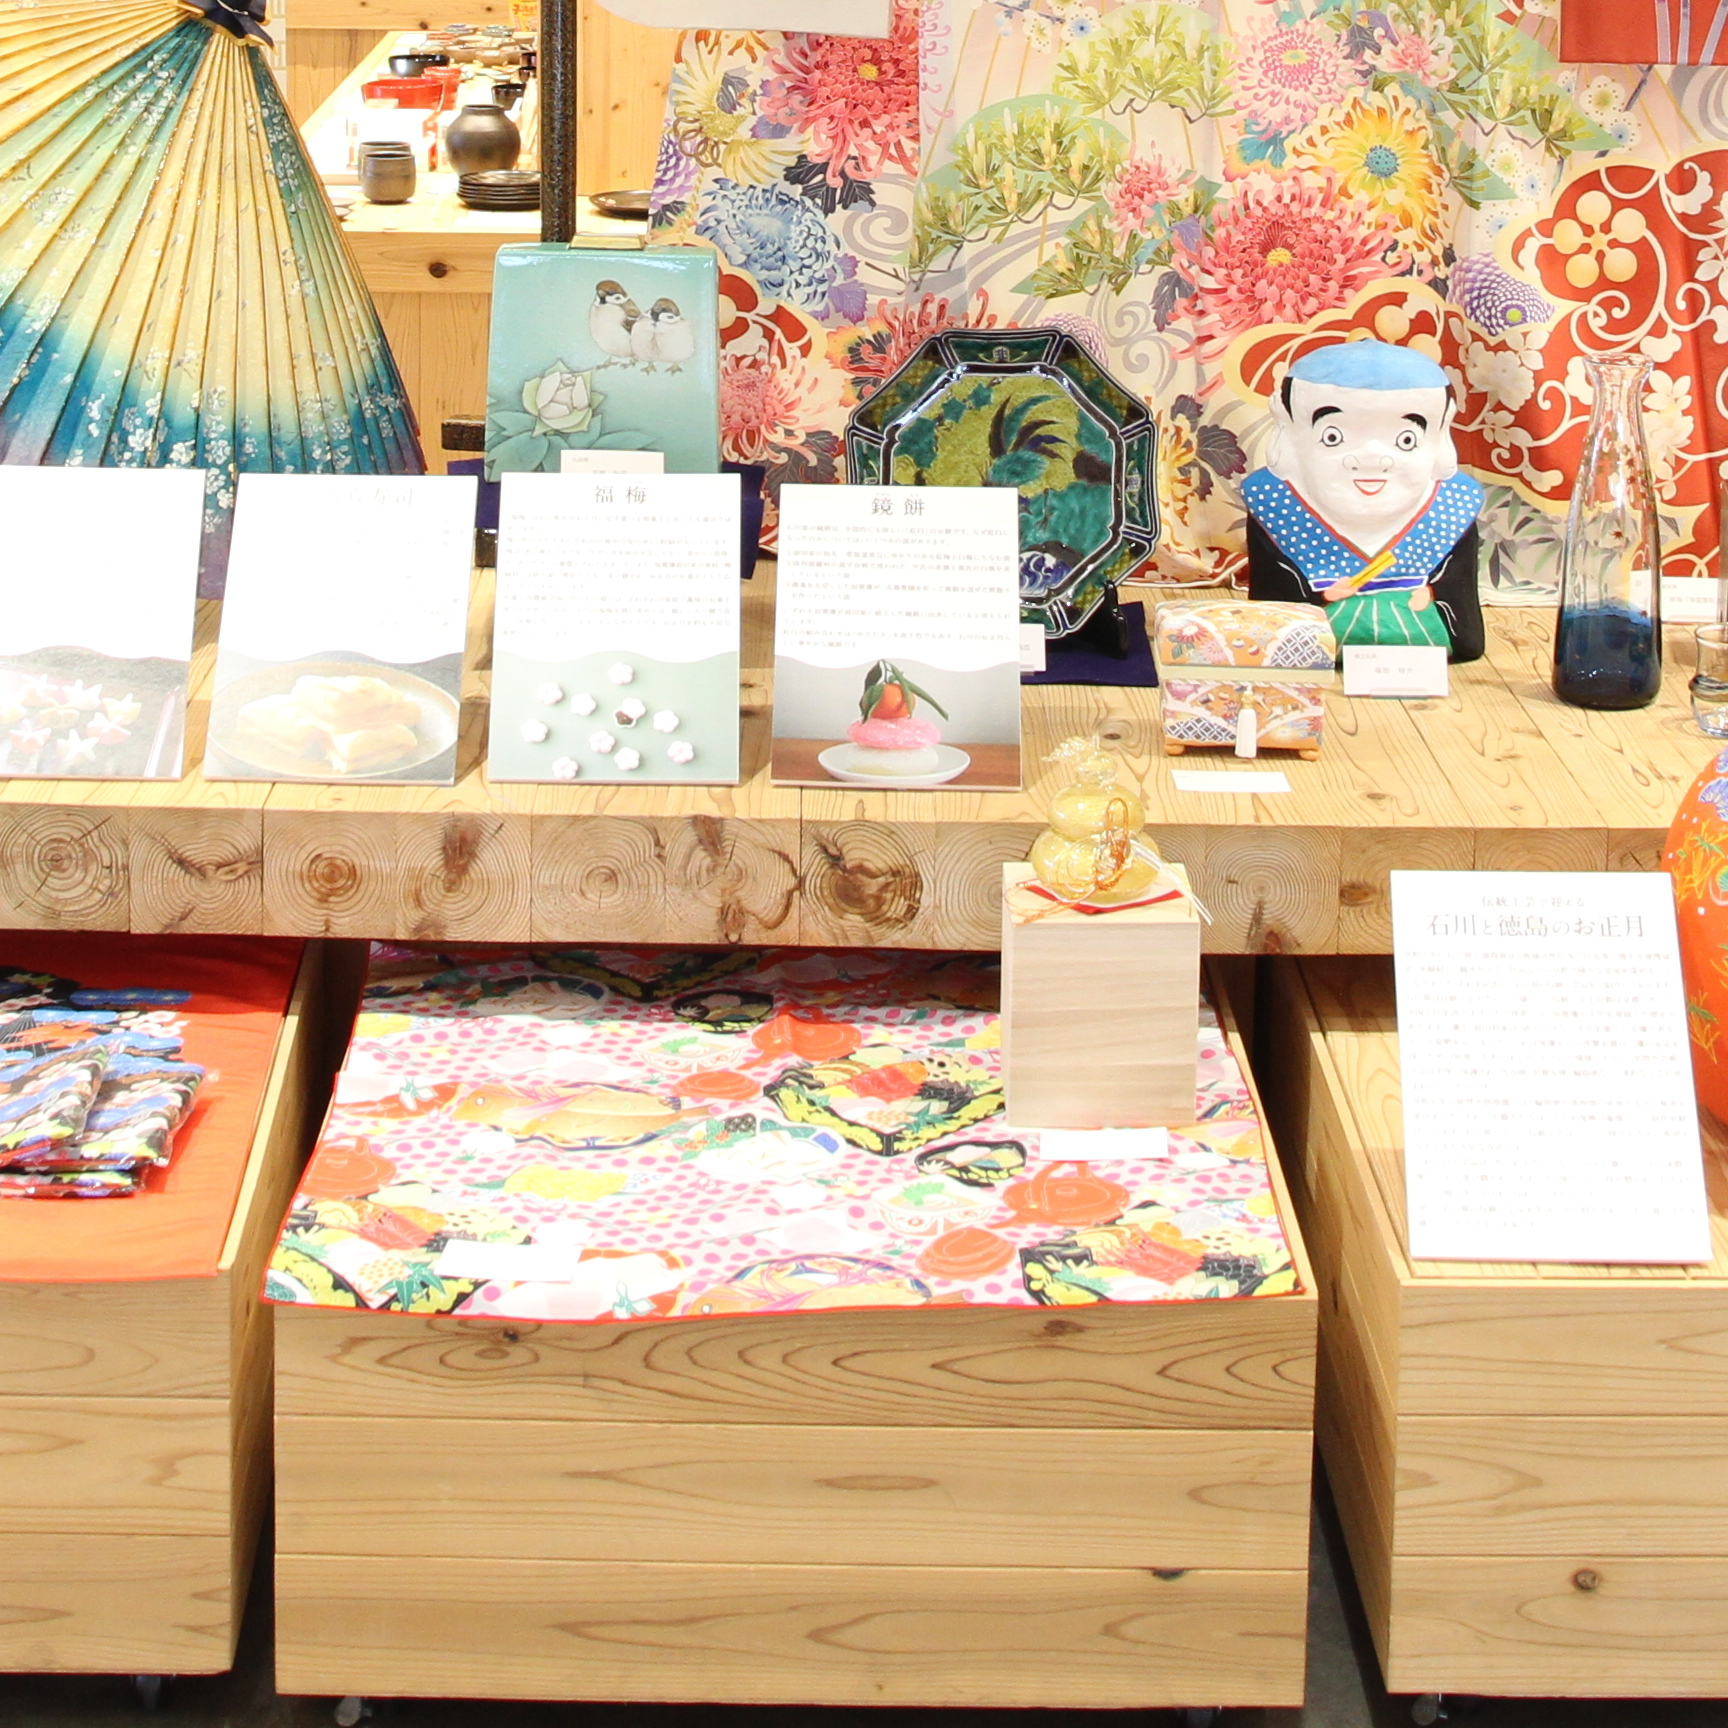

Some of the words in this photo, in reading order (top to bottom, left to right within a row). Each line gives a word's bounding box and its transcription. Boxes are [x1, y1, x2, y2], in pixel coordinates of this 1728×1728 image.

[594, 485, 647, 504] 福梅
[871, 497, 925, 517] 鏡餅
[1482, 896, 1585, 908] 伝統工芸で迎える
[1428, 914, 1645, 937] 石川と徳島のお正月
